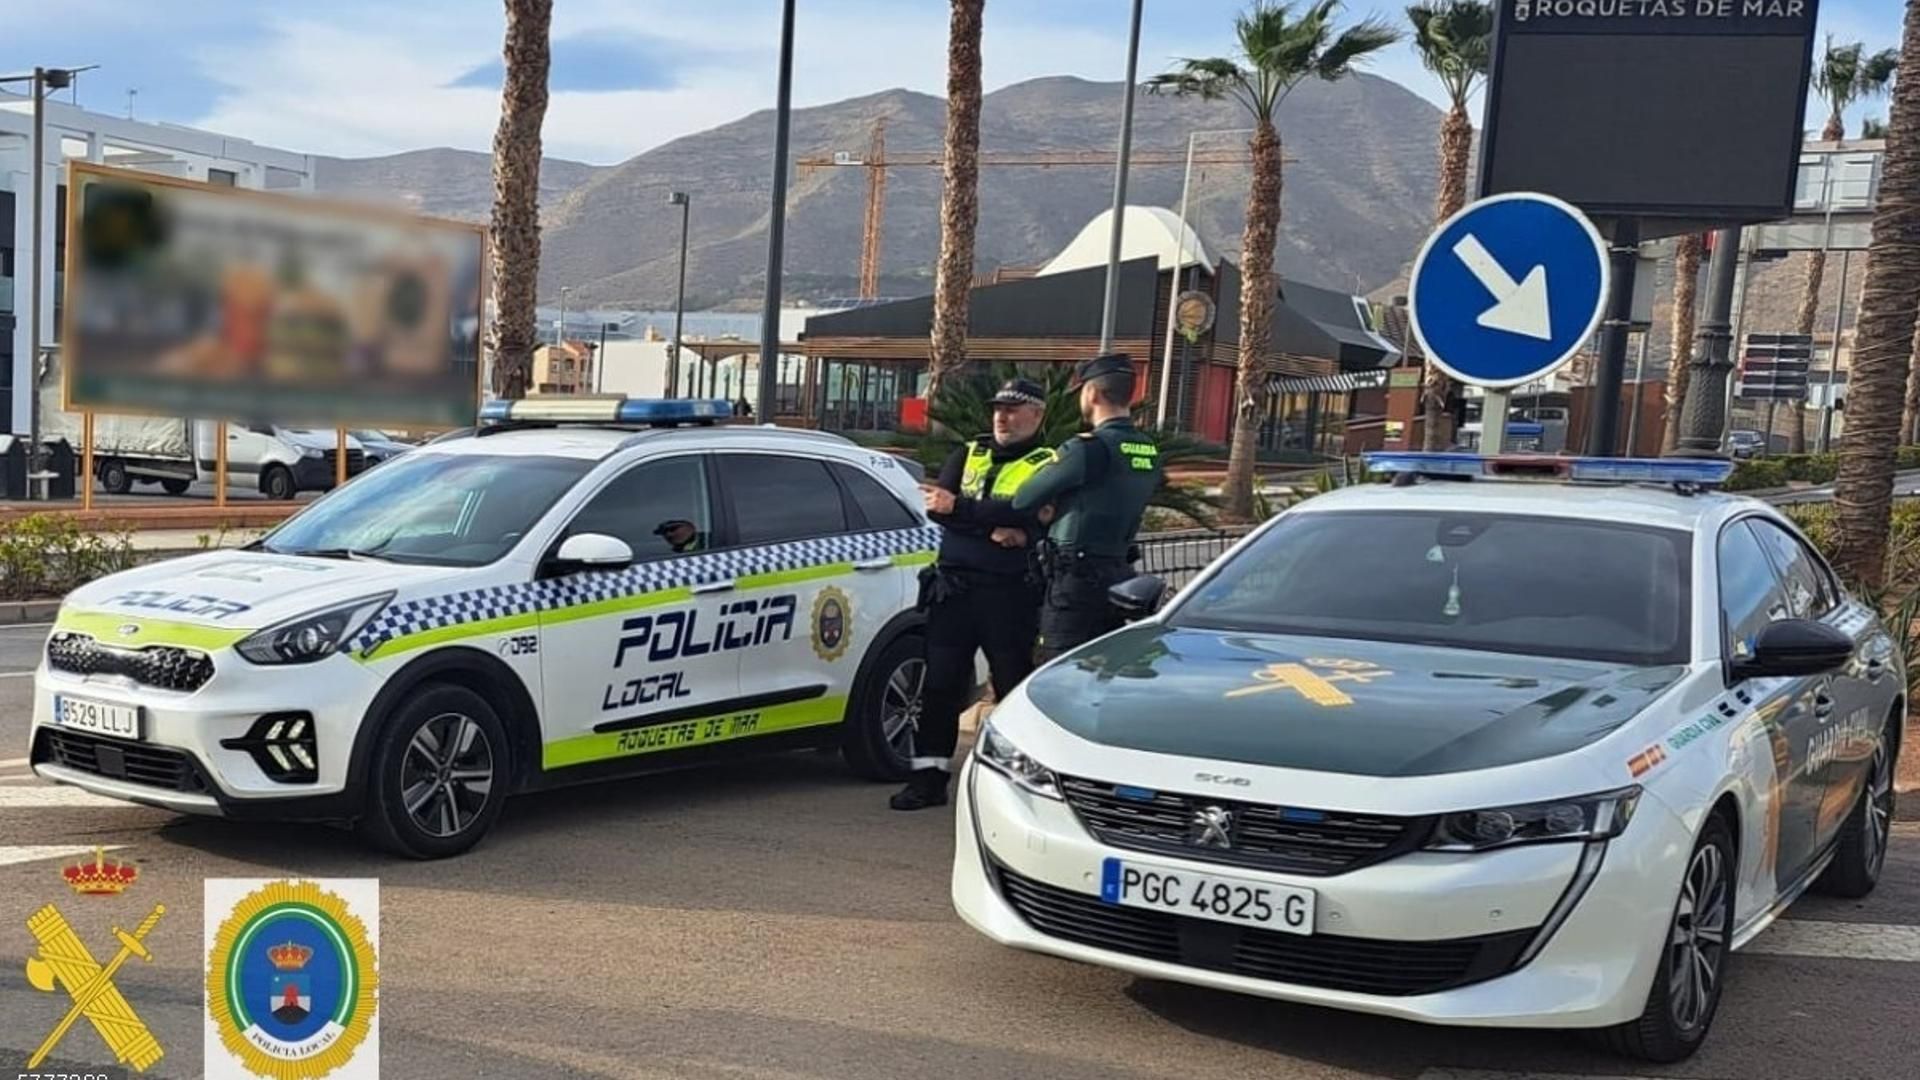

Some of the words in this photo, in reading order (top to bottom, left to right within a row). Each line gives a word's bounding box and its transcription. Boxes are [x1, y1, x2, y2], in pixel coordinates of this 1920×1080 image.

[1535, 0, 1686, 16] ROQUETAS
[1695, 0, 1733, 16] DE
[1742, 0, 1804, 16] MAR
[1120, 442, 1157, 455] GUARDIA
[1131, 457, 1153, 470] CIVIL
[602, 671, 691, 711] LOCAL
[63, 699, 97, 727] 8529
[101, 706, 132, 733] LLJ
[617, 722, 698, 751] ROQUETAS
[704, 718, 725, 738] DE
[1123, 868, 1181, 906] PGC
[1190, 879, 1273, 922] 4825
[1284, 895, 1305, 928] G
